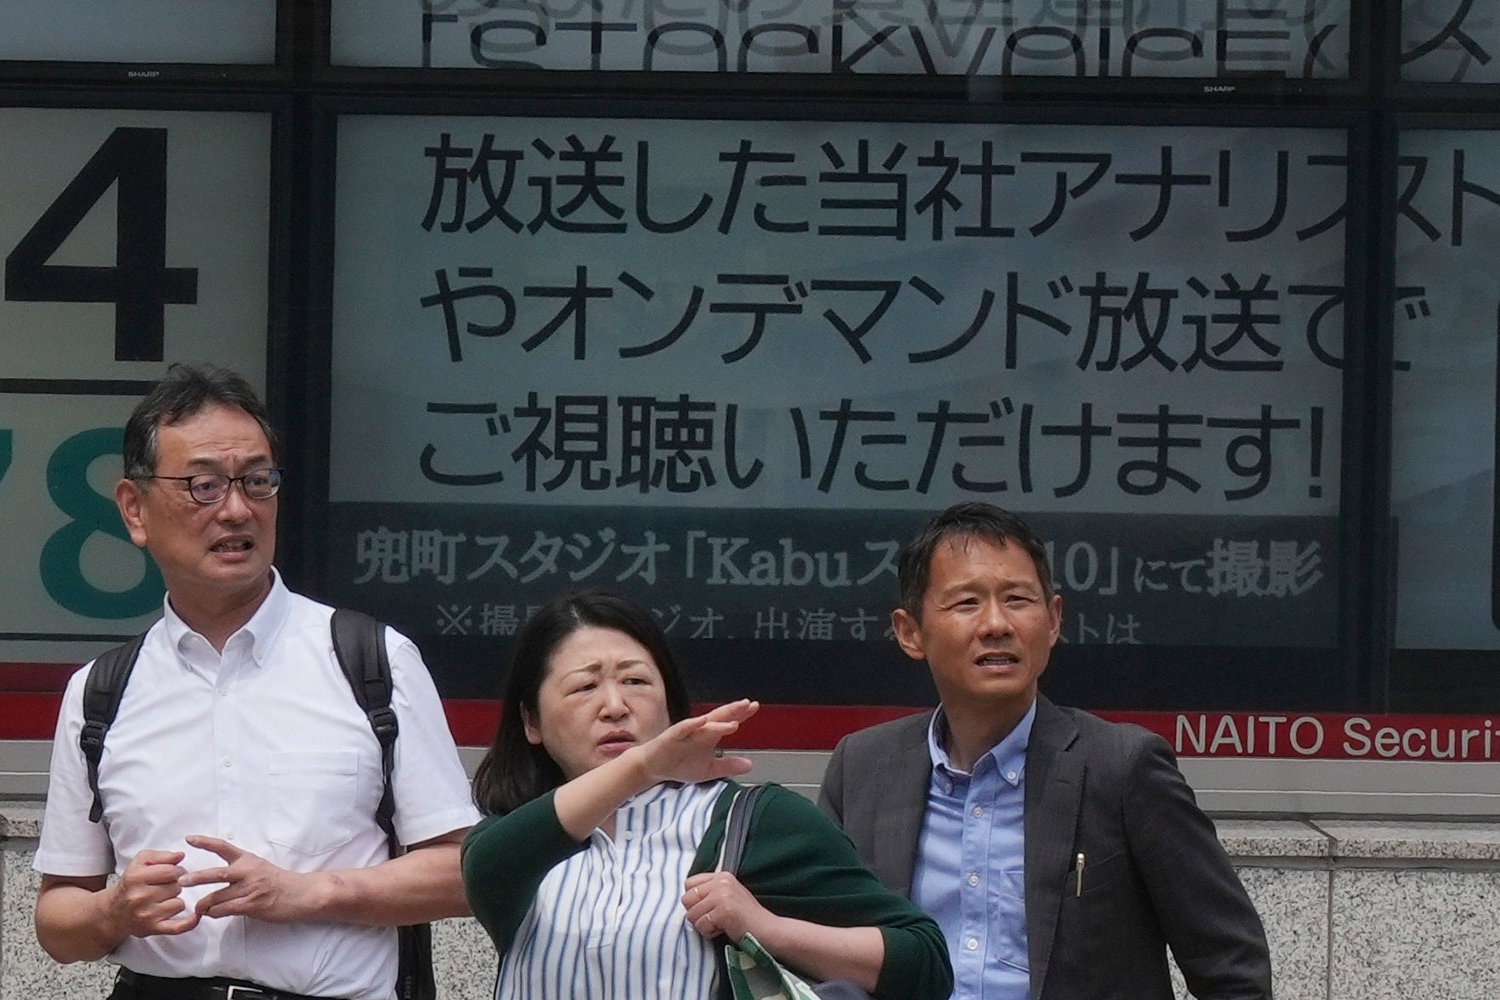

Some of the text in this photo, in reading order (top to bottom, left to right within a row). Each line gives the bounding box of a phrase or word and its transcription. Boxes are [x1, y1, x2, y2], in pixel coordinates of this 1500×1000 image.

[421, 131, 1500, 247] 放送した当社アナリスト
[419, 264, 1432, 373] やオンデマンド放送で
[419, 391, 1326, 502] ご視聴いただけます!
[1175, 714, 1500, 758] NAITO Securi
